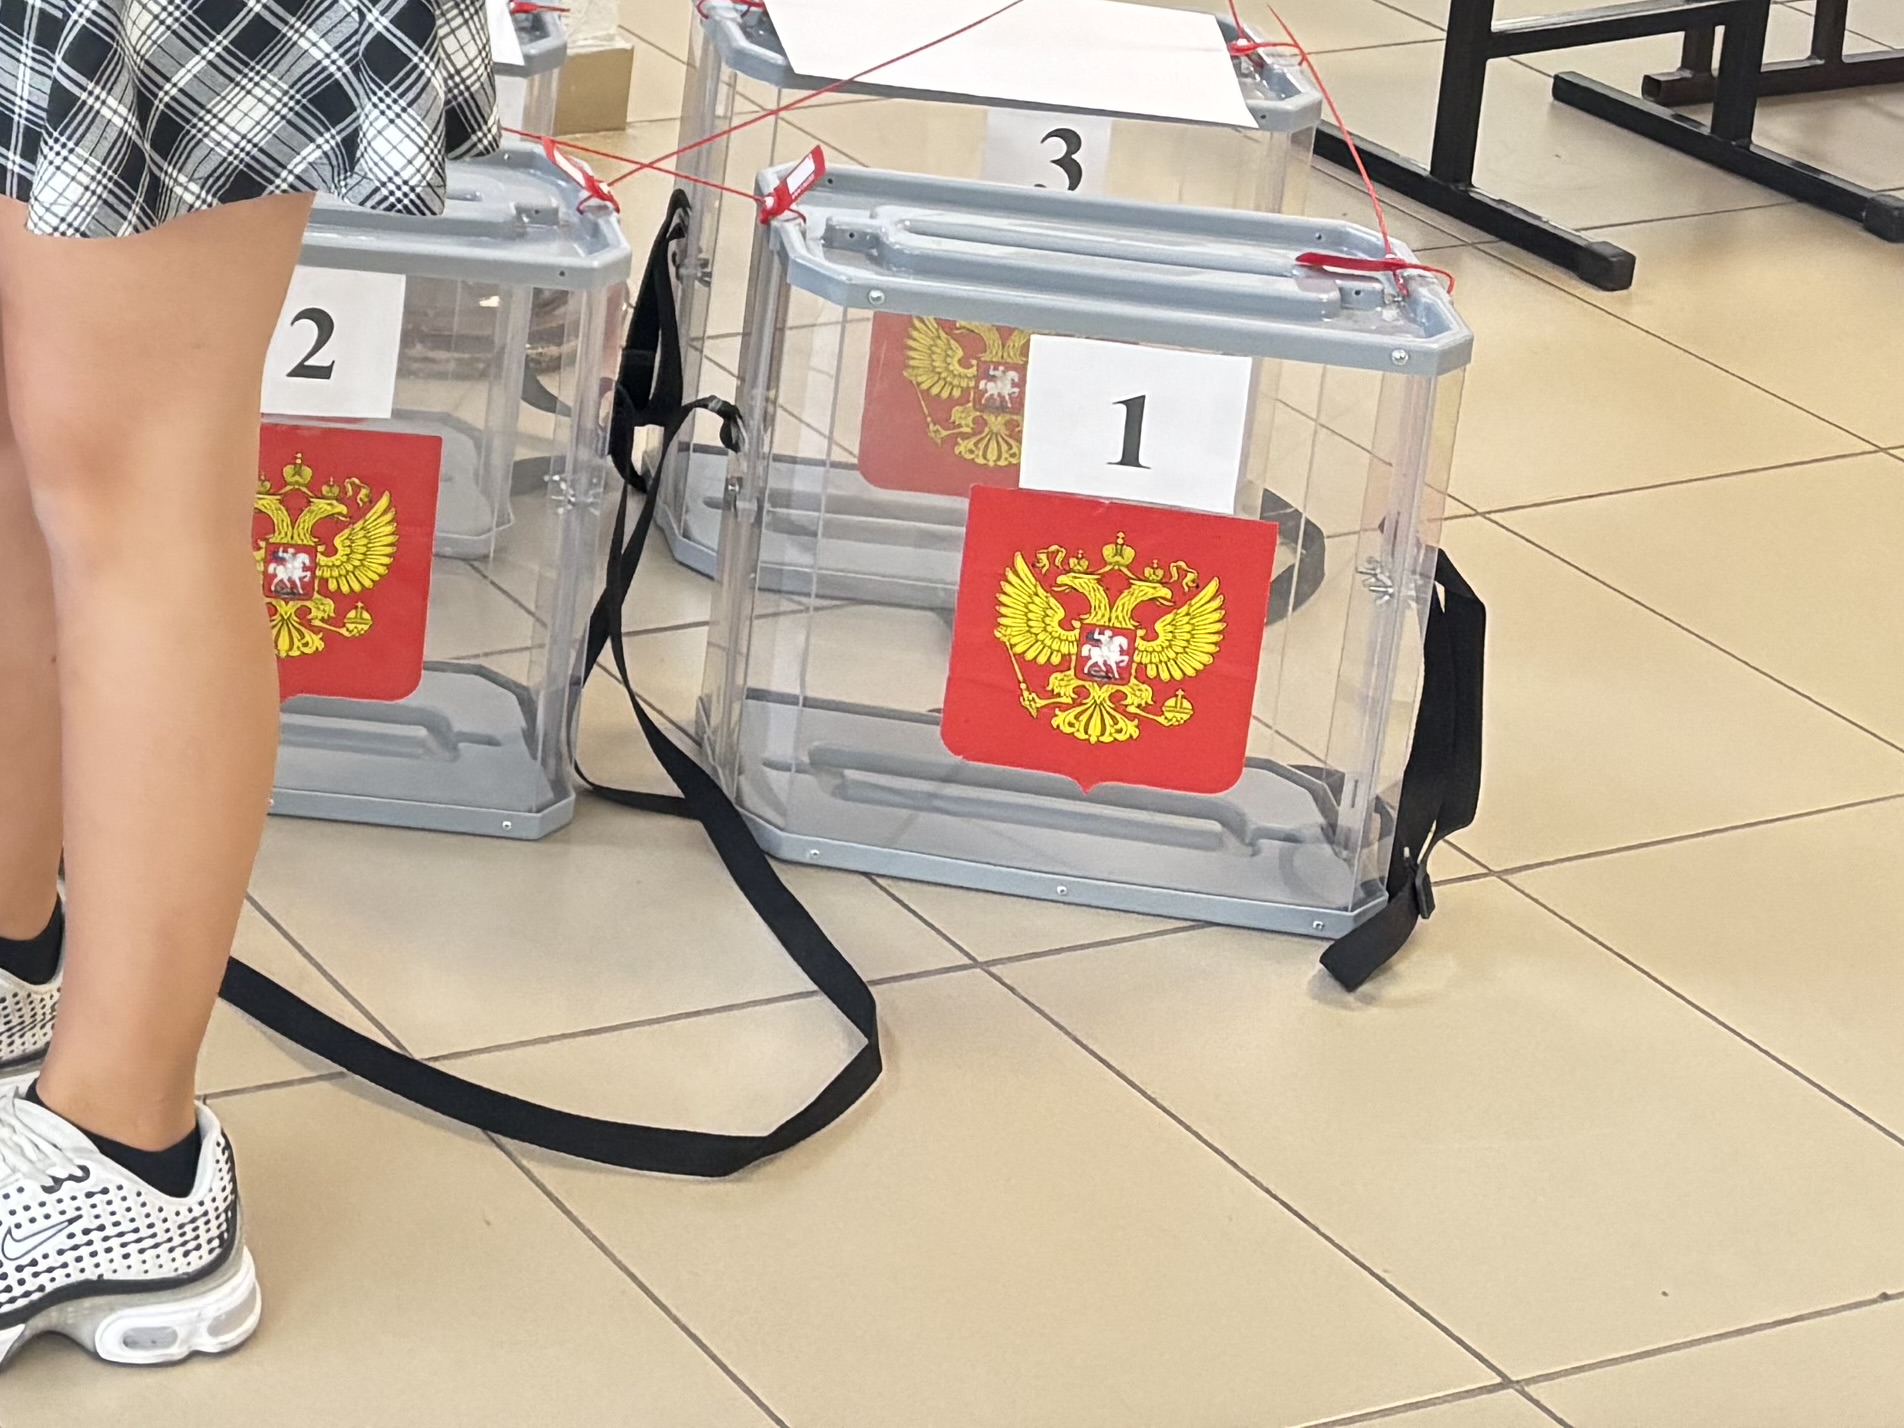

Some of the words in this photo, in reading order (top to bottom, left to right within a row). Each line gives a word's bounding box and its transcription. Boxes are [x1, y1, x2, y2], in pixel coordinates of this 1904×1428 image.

[1034, 127, 1083, 191] 3
[286, 307, 335, 380] 2
[1106, 394, 1152, 470] 1
